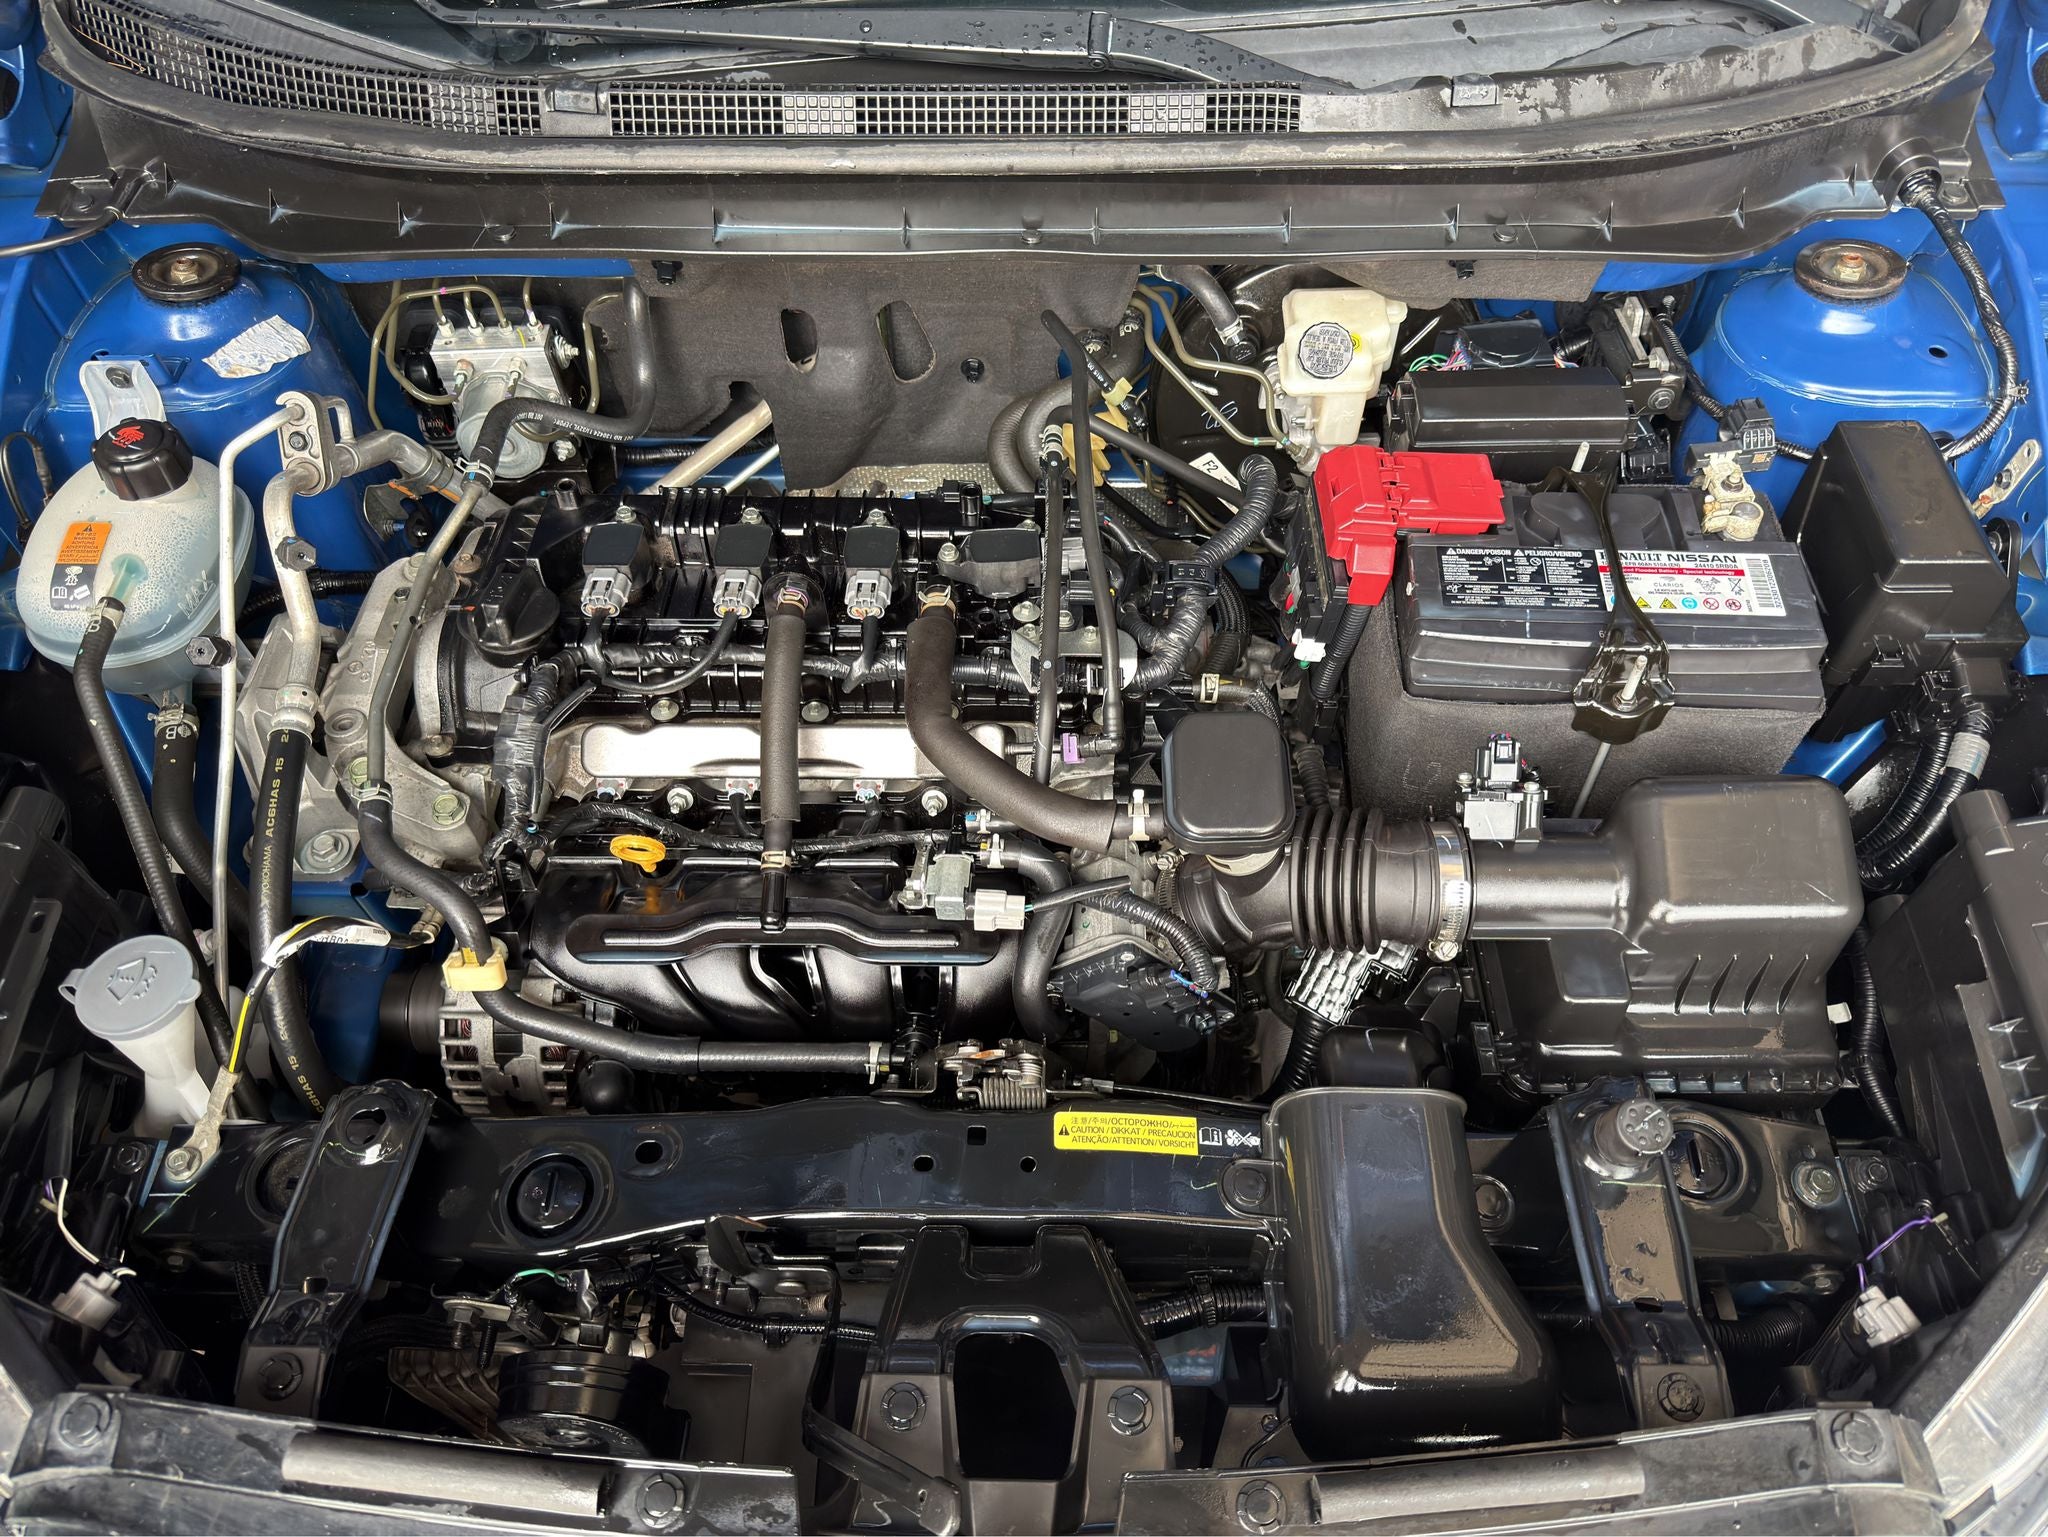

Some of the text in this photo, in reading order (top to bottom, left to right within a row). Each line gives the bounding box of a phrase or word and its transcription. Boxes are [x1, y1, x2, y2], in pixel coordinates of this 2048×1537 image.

[1202, 459, 1219, 474] F2
[1456, 548, 1512, 556] DANGER/POISON
[1524, 550, 1583, 558] PELIGRO/VENENO
[1667, 553, 1738, 563] NISSAN
[165, 725, 178, 740] B
[261, 845, 273, 897] YOKOHAMA
[274, 756, 285, 773] 15
[297, 1075, 325, 1113] C6HAS
[1070, 1125, 1105, 1134] CAUTION
